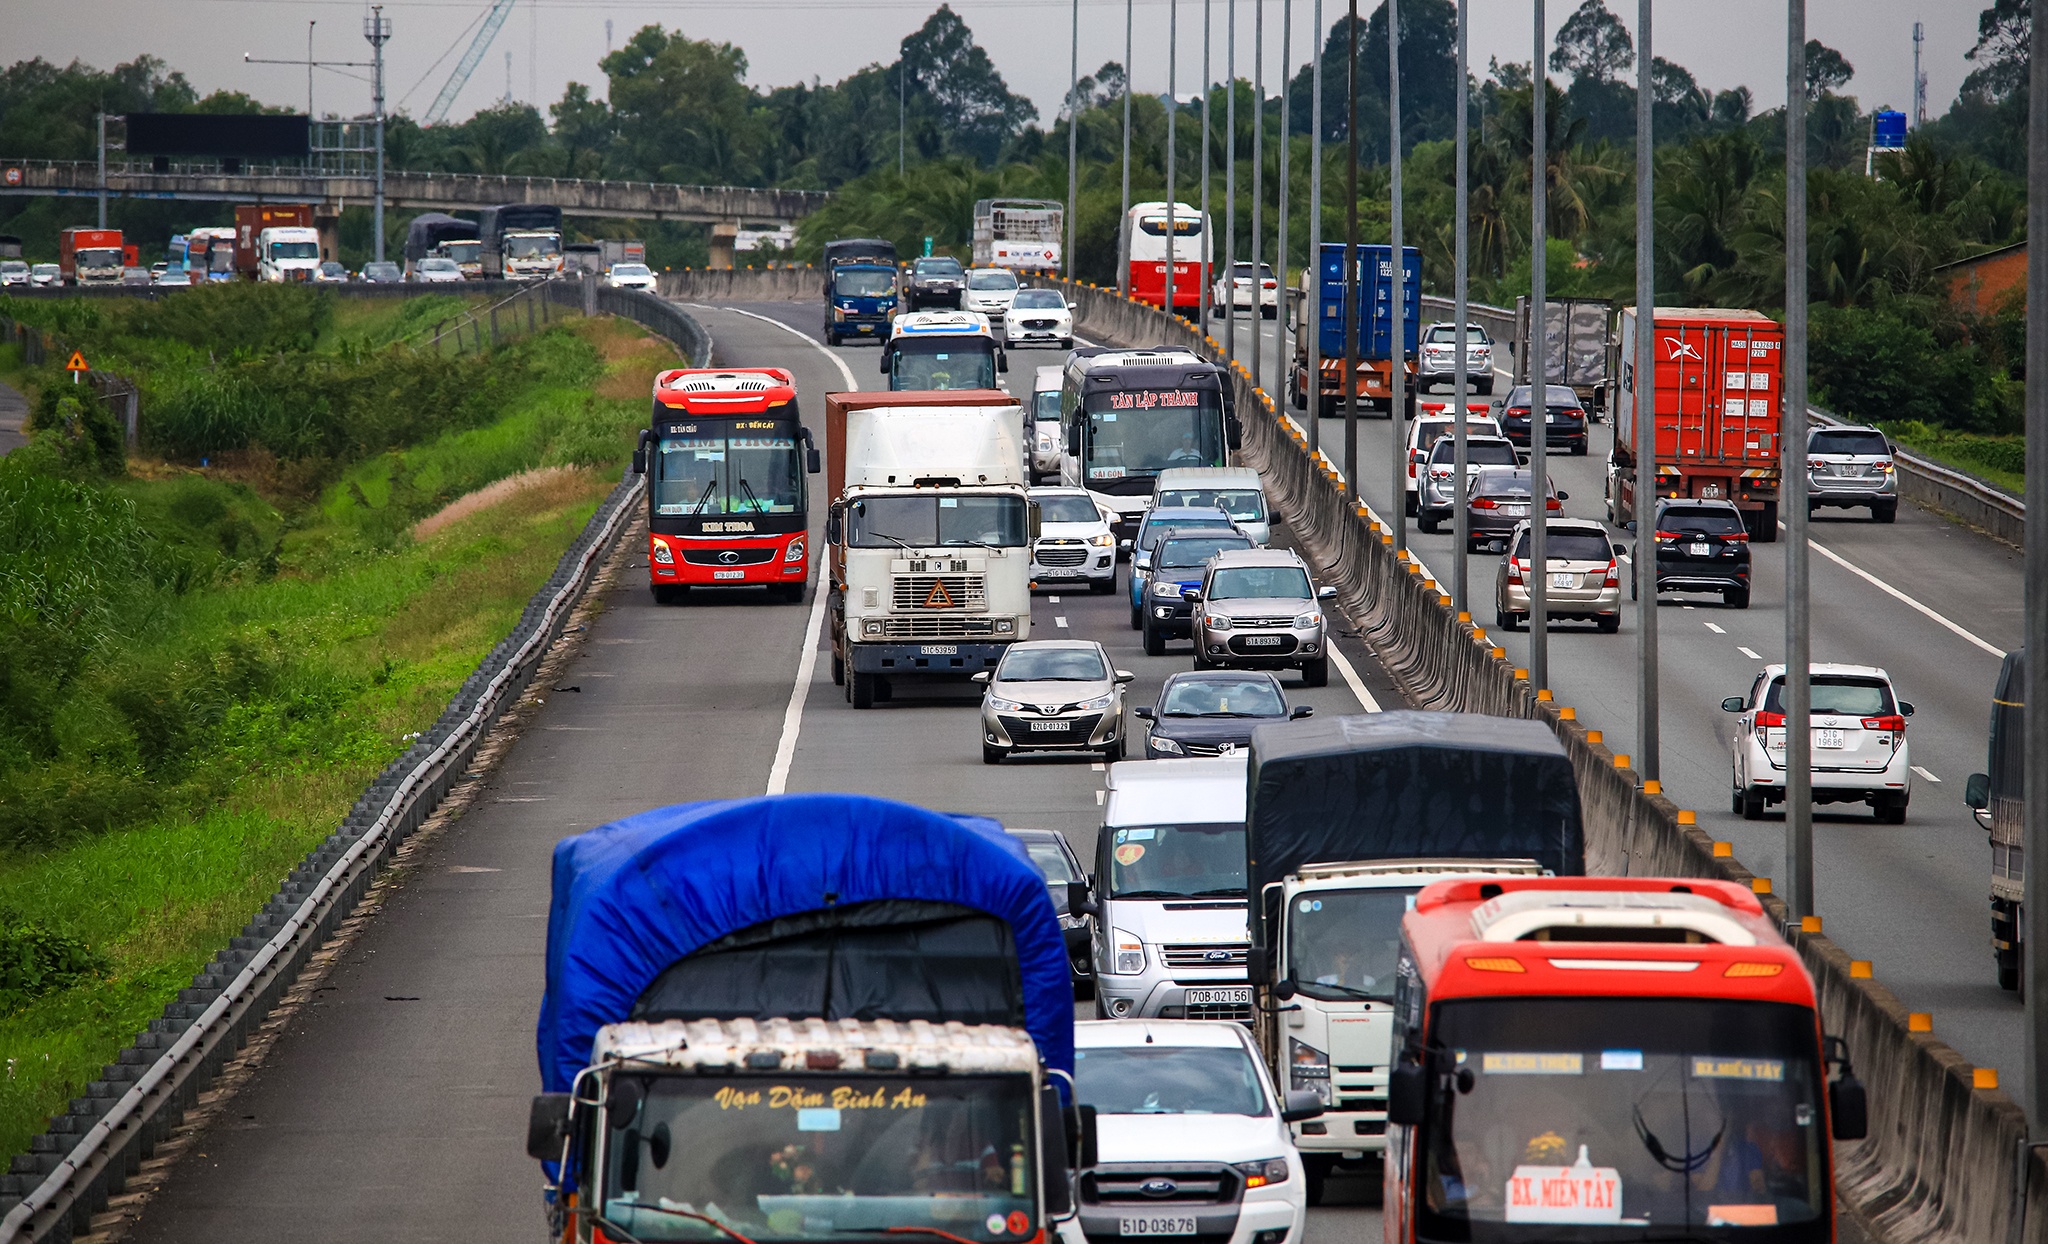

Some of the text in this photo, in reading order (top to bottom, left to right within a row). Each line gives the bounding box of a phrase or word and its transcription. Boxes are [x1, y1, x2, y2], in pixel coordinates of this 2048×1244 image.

[702, 521, 755, 532] KIM THOA
[1823, 730, 1838, 738] 51G
[891, 1086, 928, 1110] An
